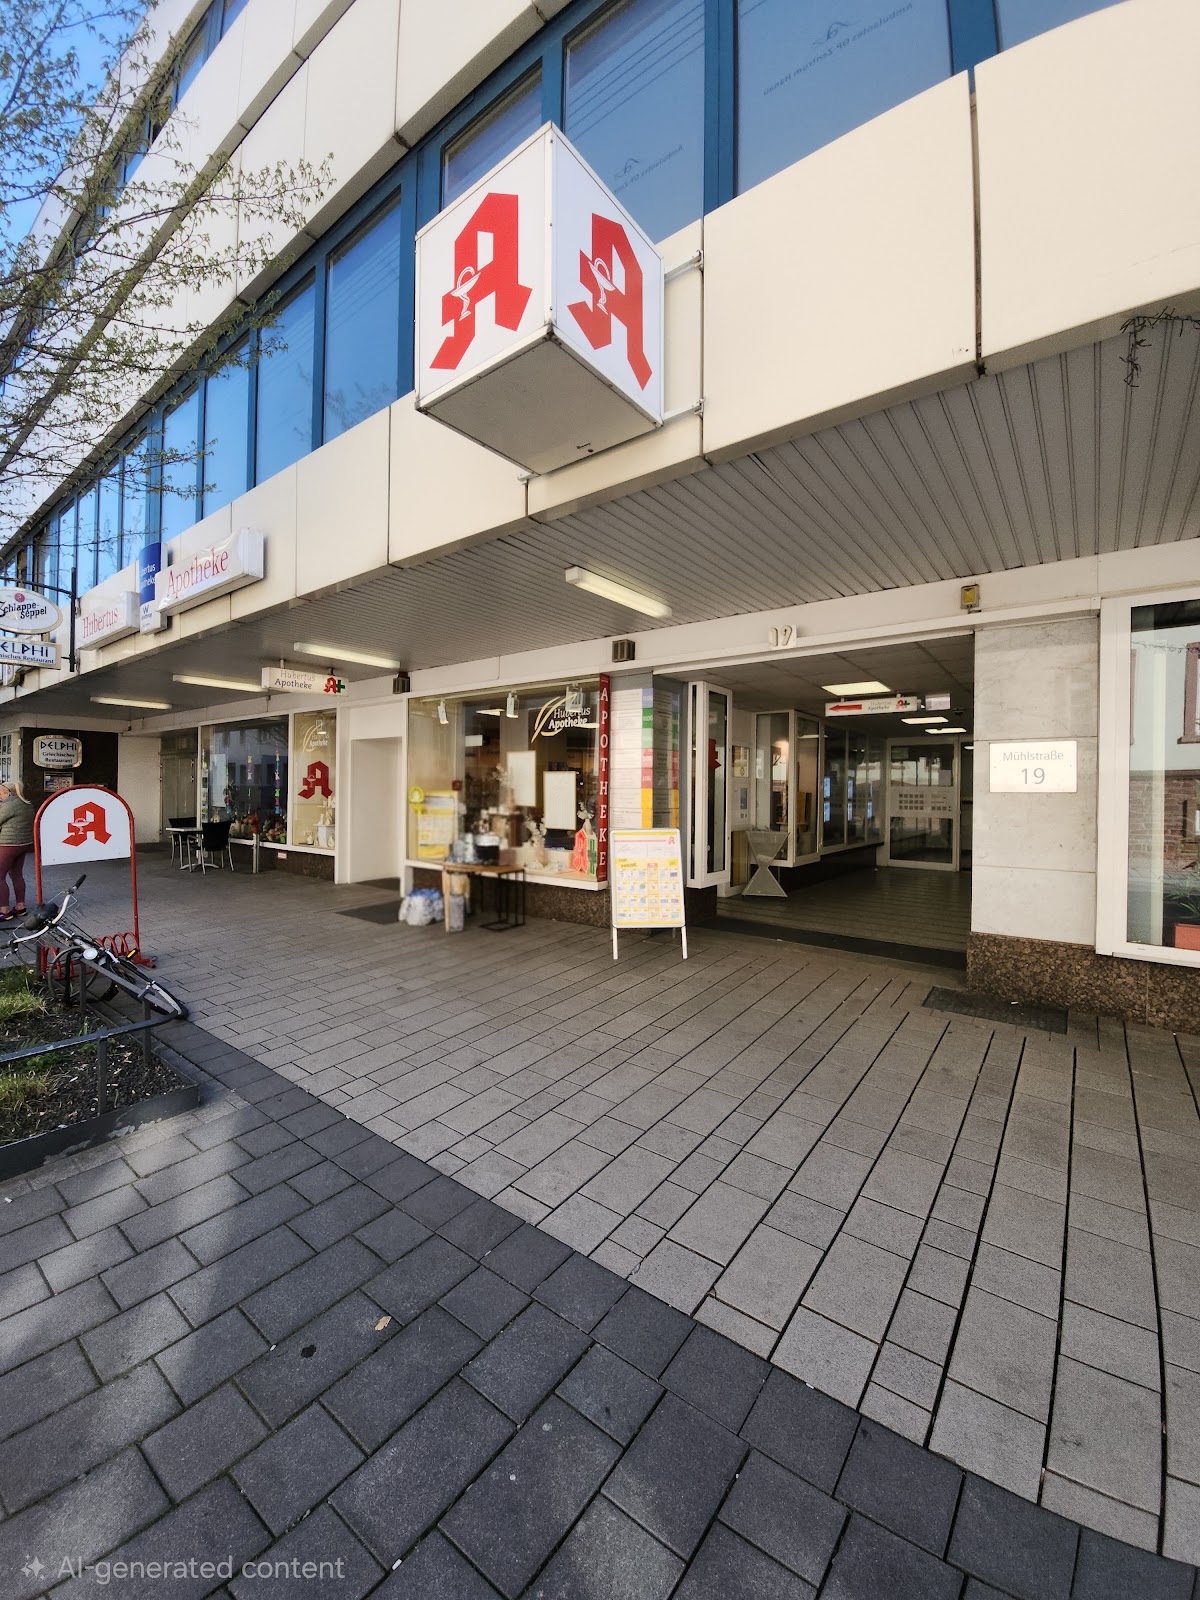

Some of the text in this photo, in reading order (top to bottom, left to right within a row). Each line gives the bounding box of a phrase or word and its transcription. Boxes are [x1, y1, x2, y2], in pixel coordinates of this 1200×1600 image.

[82, 547, 229, 638] Hubertus Apotheke
[0, 641, 49, 657] ELPHI
[22, 655, 54, 664] Restaurant
[280, 669, 316, 682] Hubertus
[274, 678, 313, 690] Apotheke
[548, 716, 588, 732] Apotheke
[41, 741, 77, 751] DELPHI
[1002, 750, 1064, 761] Mühlstraße
[599, 688, 609, 867] APOTHEKE
[1021, 767, 1046, 785] 19
